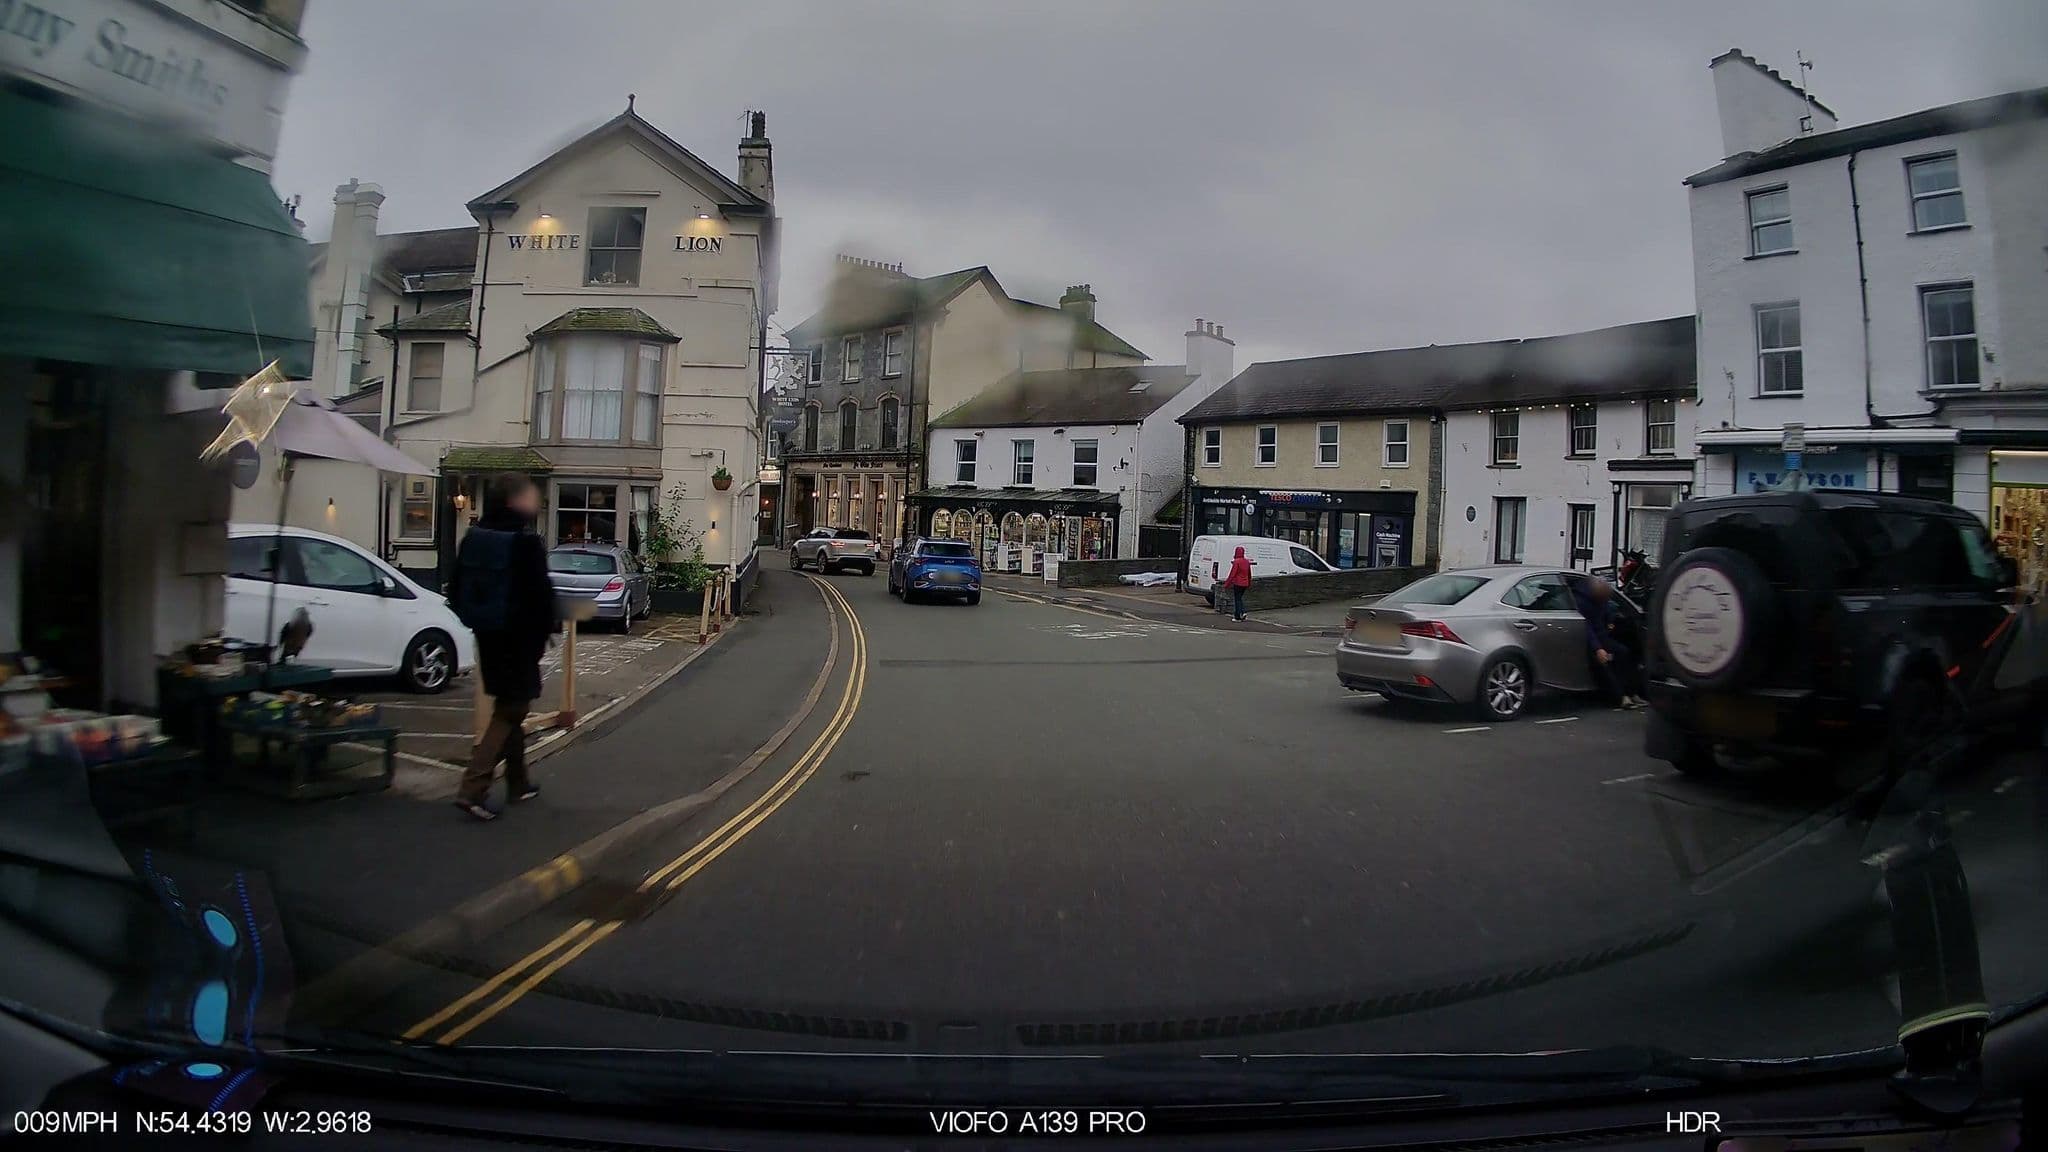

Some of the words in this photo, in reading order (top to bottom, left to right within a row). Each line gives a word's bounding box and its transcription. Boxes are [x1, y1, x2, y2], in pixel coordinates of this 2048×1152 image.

[84, 18, 229, 107] Smiths
[508, 234, 580, 250] WHITE
[674, 236, 724, 253] LION
[1269, 494, 1293, 503] TESCO
